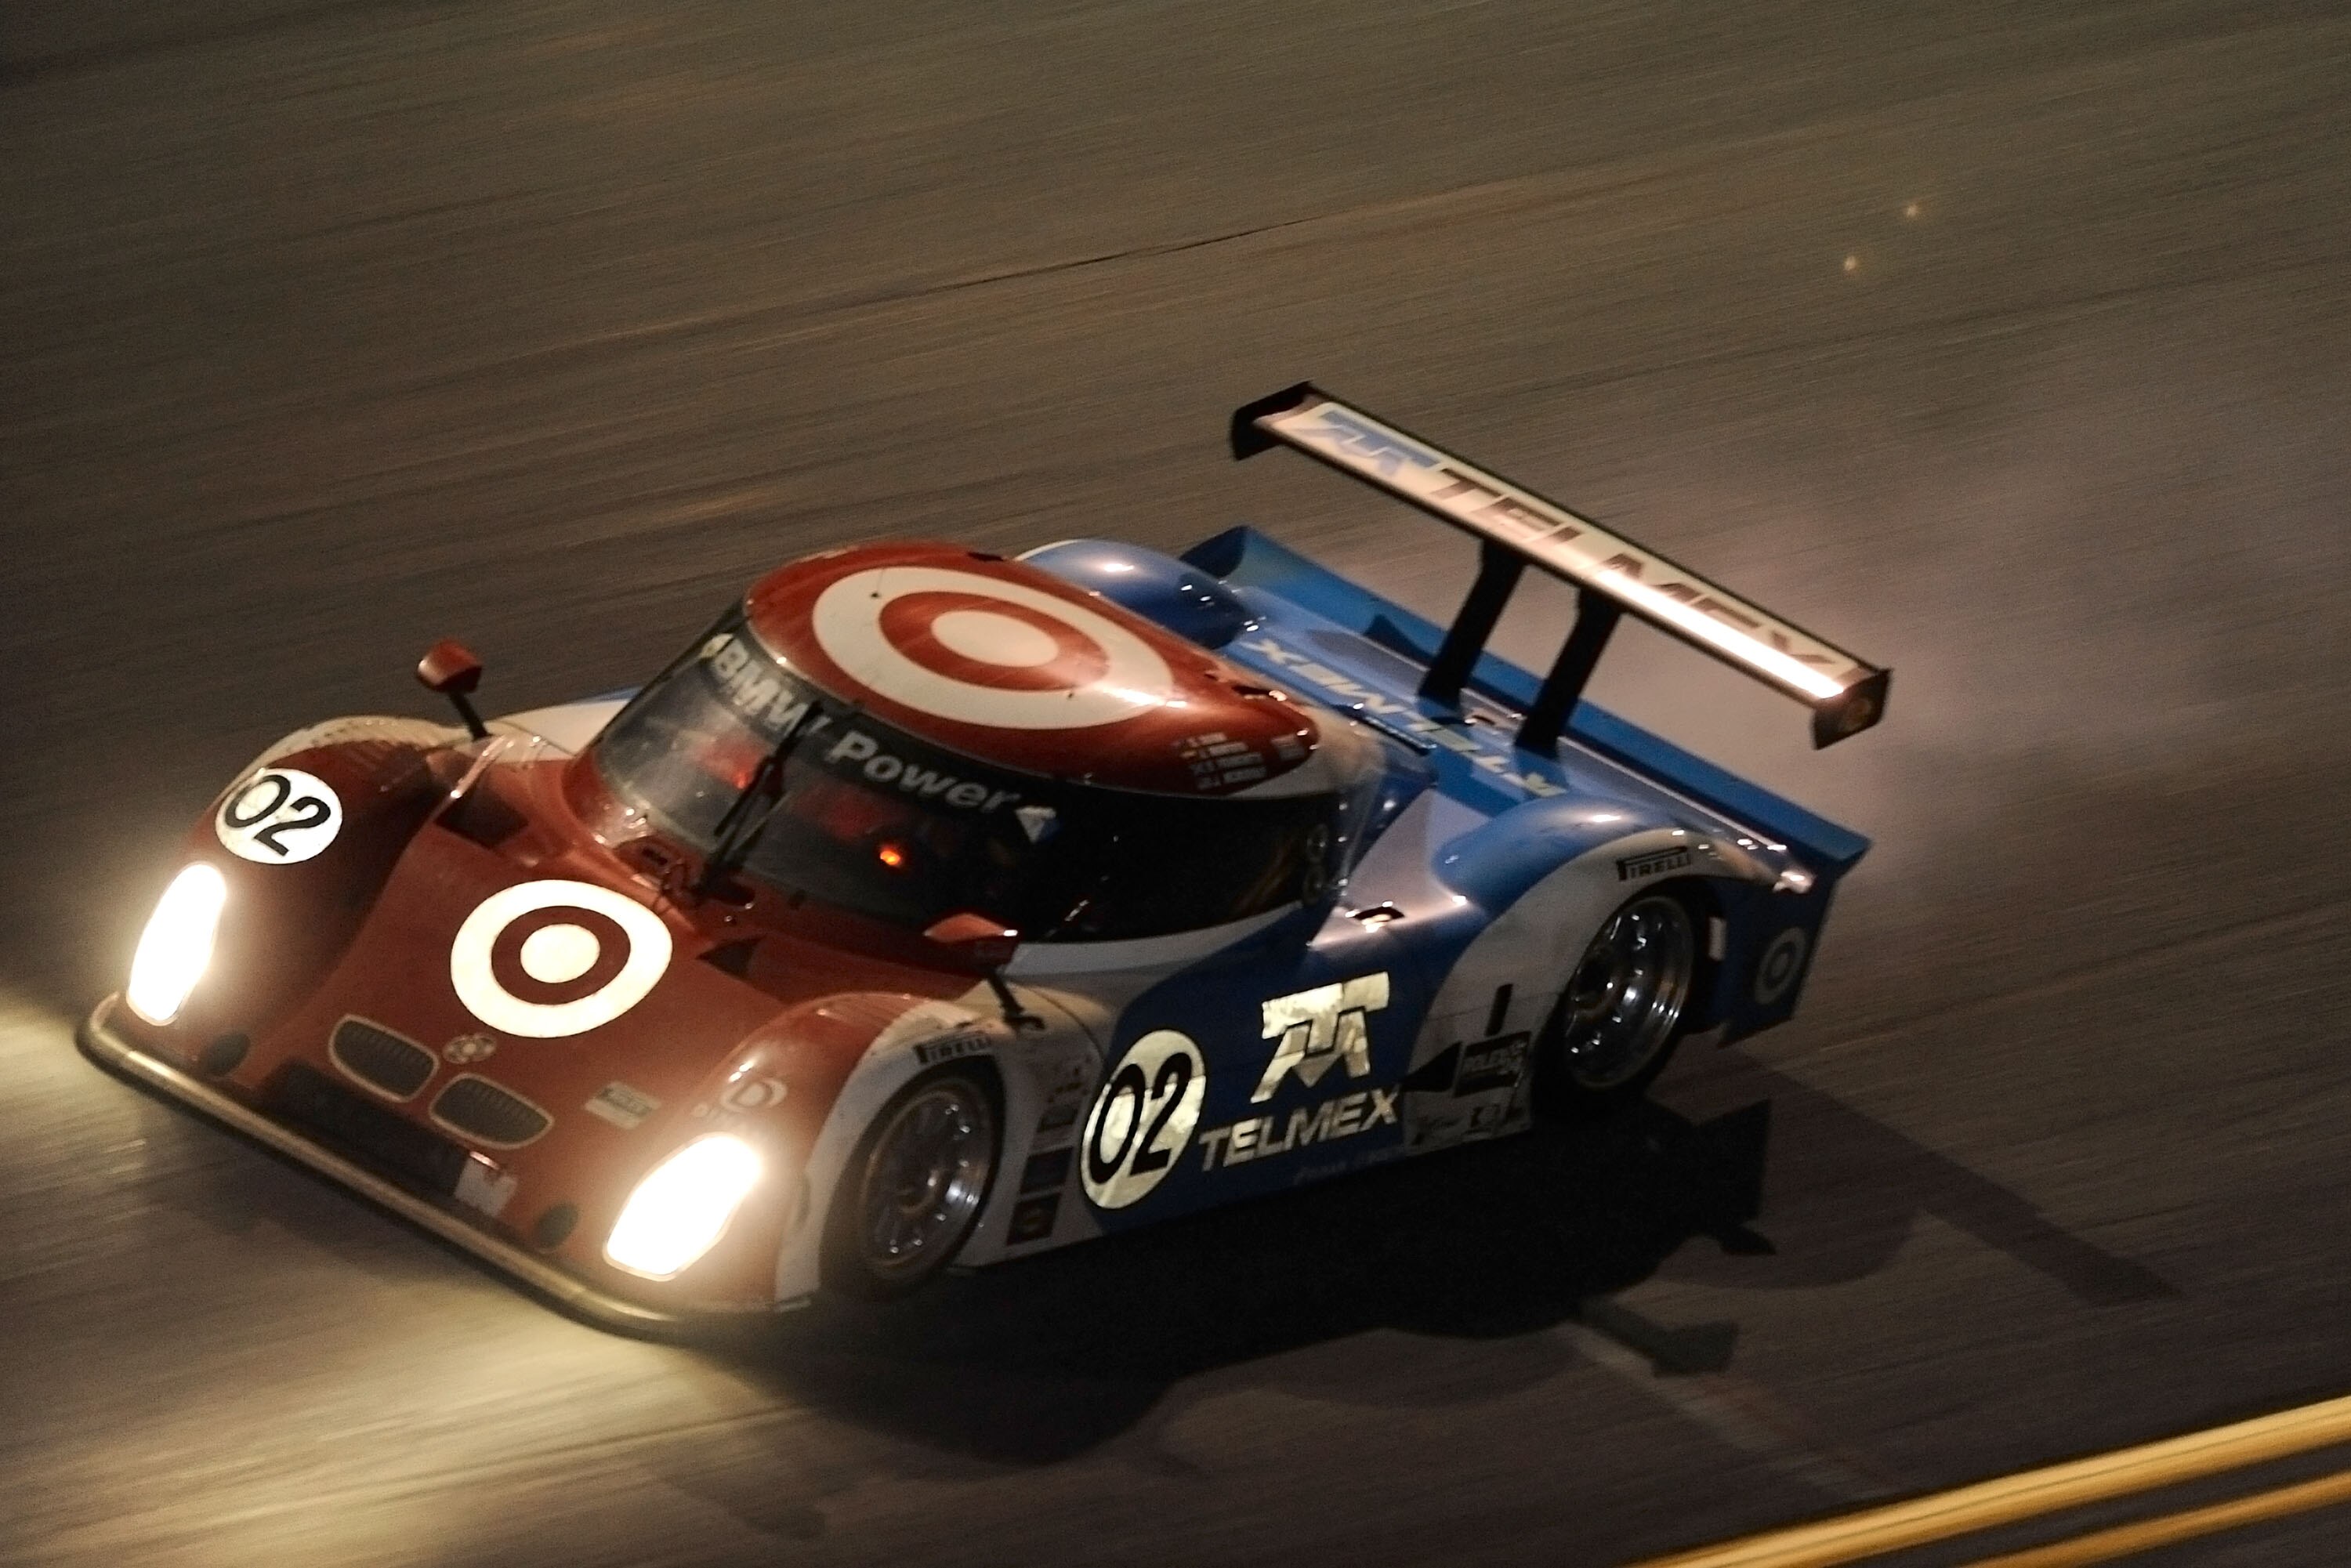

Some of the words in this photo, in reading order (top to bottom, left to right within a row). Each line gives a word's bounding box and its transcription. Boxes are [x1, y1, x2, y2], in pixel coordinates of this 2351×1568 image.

[828, 730, 1020, 810] Power
[224, 774, 331, 856] 02
[1090, 1052, 1193, 1184] 02
[1198, 1086, 1399, 1171] TELMEX
